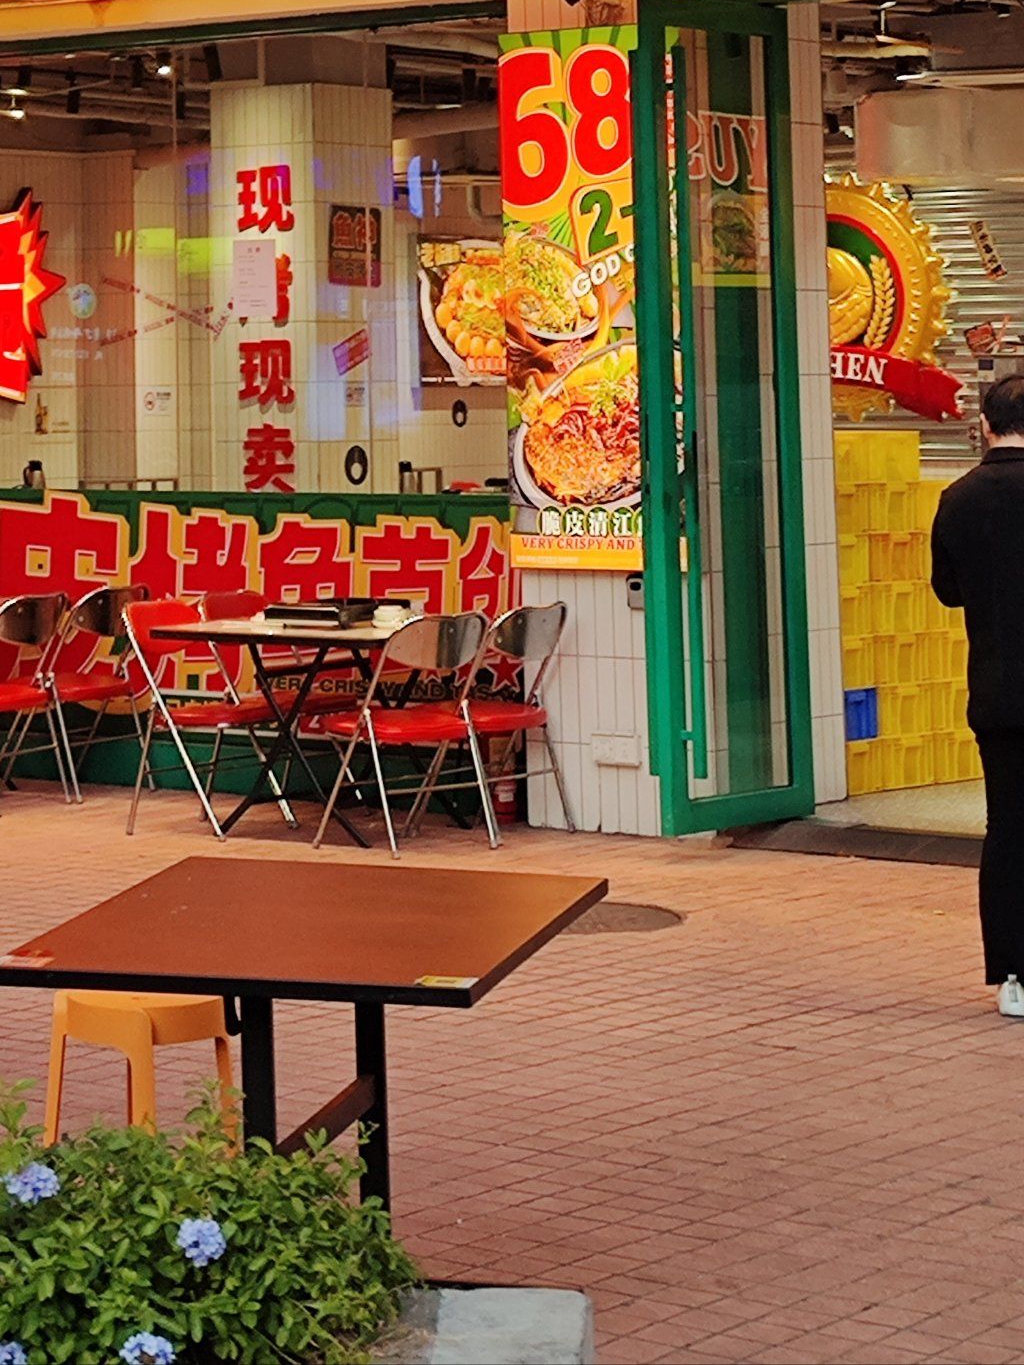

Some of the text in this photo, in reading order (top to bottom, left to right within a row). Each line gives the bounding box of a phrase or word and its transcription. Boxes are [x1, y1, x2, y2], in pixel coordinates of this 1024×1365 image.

[498, 49, 632, 209] 68
[572, 253, 622, 298] GOD
[541, 510, 642, 538] 脆皮清江
[522, 536, 635, 551] VERY CRISPY AND
